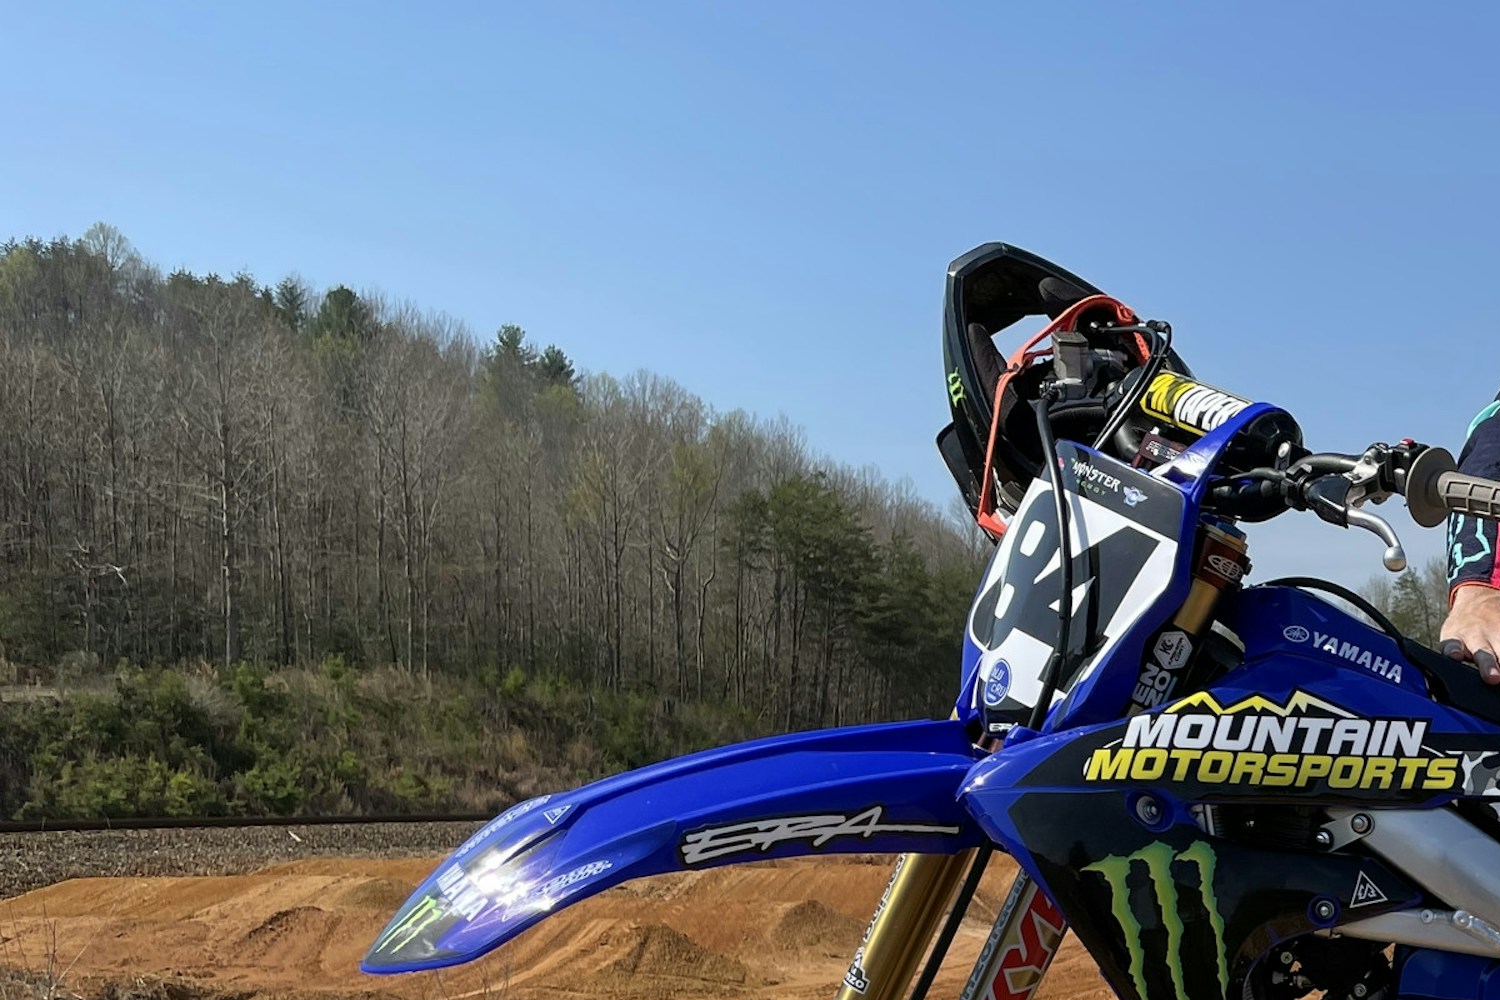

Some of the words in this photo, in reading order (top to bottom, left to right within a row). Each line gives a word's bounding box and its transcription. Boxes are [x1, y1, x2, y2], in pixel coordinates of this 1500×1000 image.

[1072, 461, 1121, 493] MONSTER
[972, 489, 1161, 690] 84
[1312, 631, 1404, 684] YAMAHA
[1122, 714, 1428, 757] MOUNTAIN
[1085, 748, 1459, 790] MOTORSPORTS
